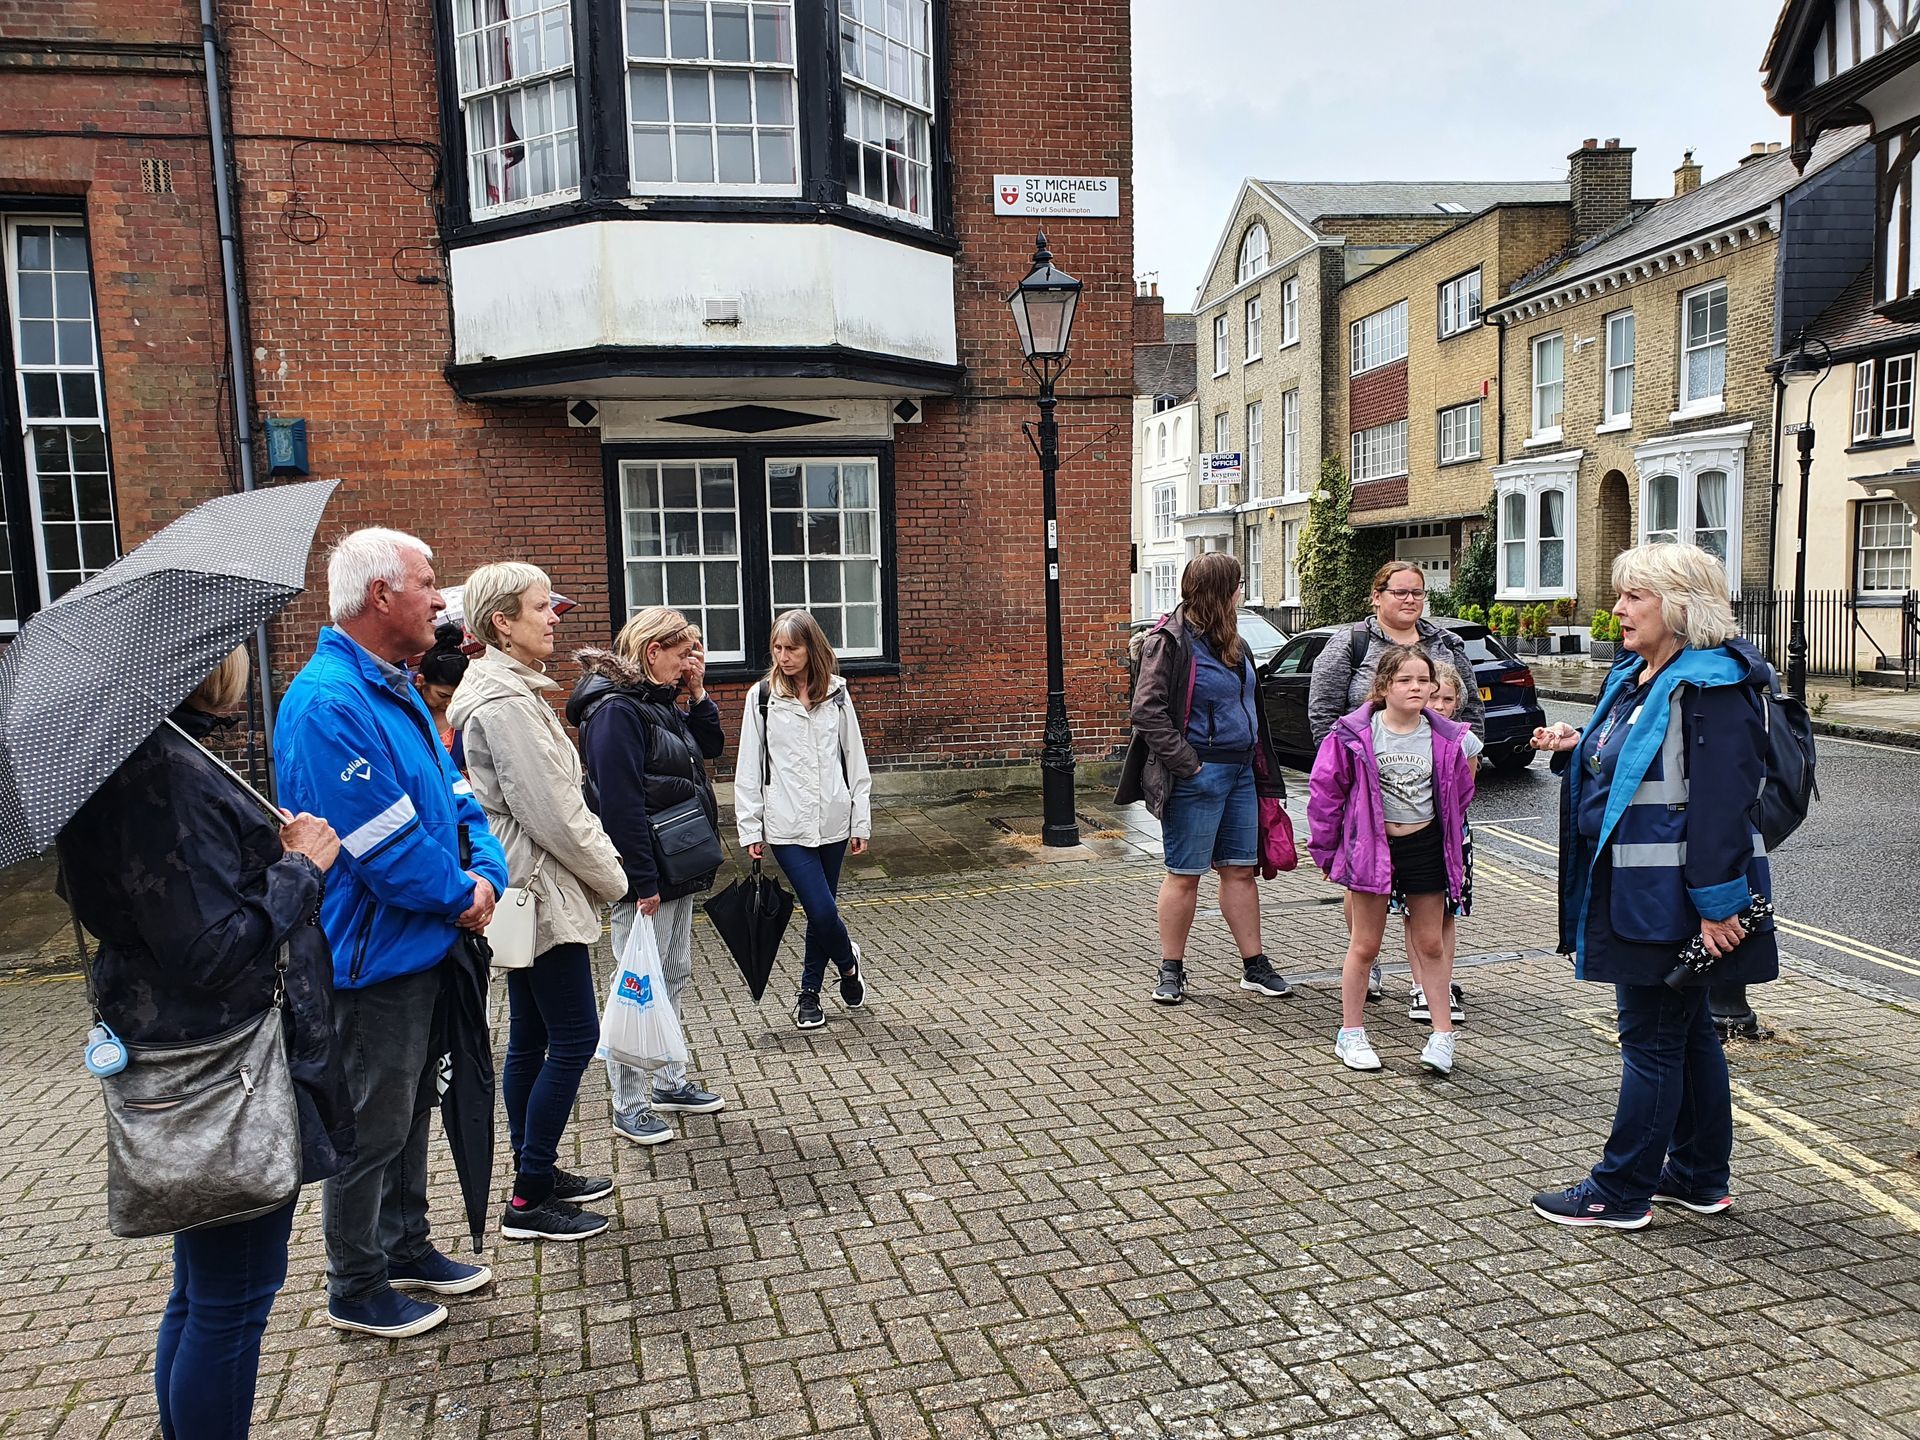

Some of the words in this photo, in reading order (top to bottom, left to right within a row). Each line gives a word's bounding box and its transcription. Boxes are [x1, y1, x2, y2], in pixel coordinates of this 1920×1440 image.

[1025, 179, 1041, 190] ST
[1045, 179, 1107, 192] MICHAELS
[1025, 192, 1076, 204] SQUARE
[1048, 206, 1091, 214] Southampton
[1203, 472, 1209, 481] TO
[1050, 522, 1056, 531] 5
[1378, 754, 1425, 766] HOGWARTS
